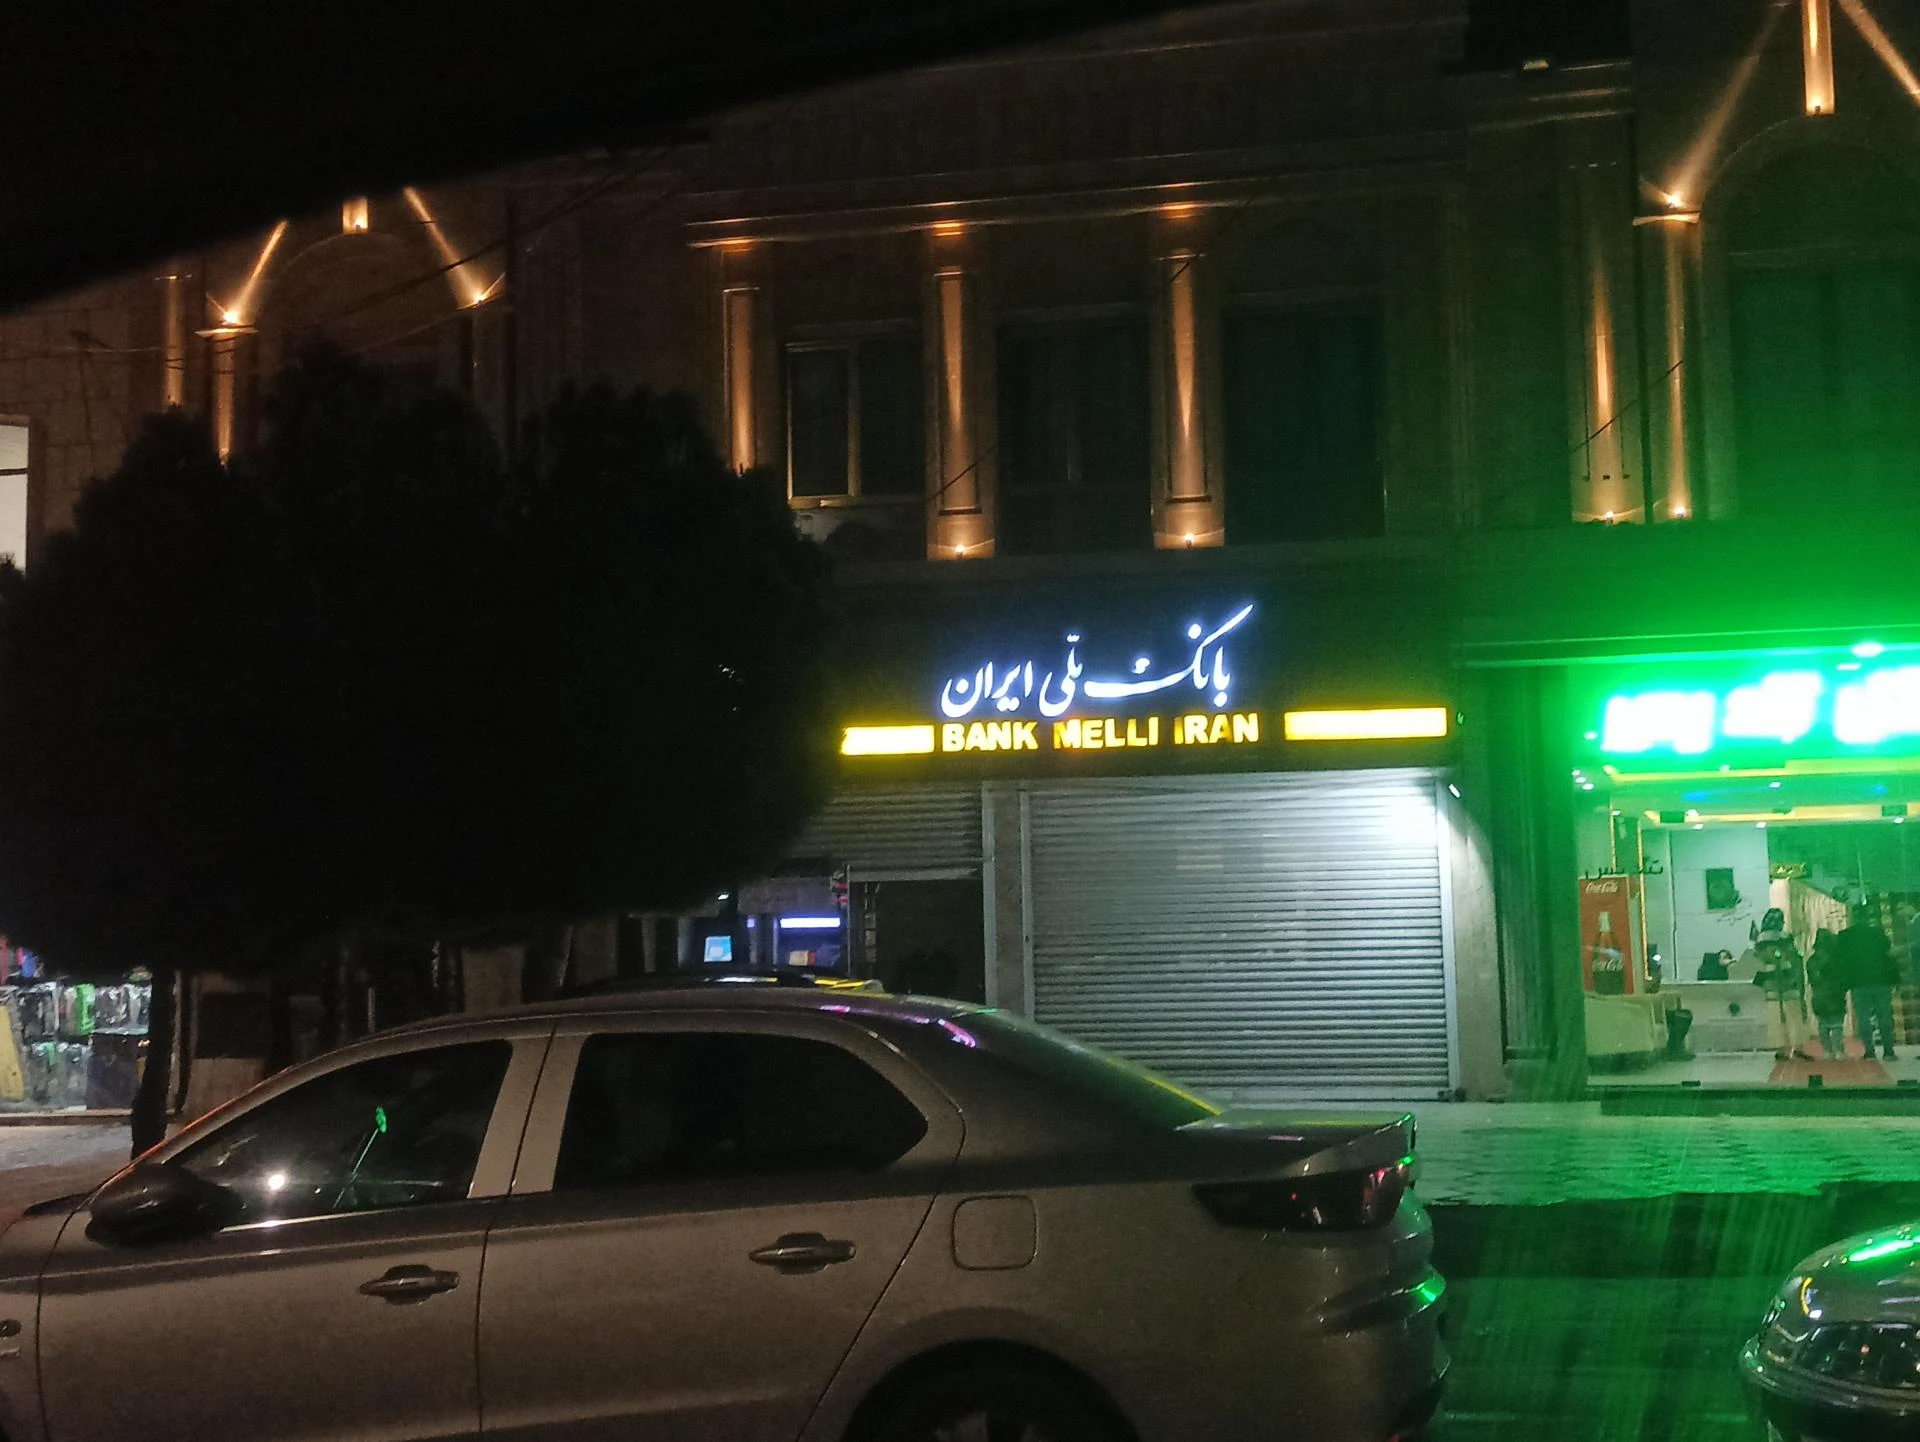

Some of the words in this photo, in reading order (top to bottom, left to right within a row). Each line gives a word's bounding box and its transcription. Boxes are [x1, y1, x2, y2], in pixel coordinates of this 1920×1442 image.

[1083, 603, 1254, 708] بانک
[940, 660, 1034, 718] ایران
[942, 719, 1039, 752] BANK
[1053, 716, 1159, 750] MELLI
[1174, 711, 1260, 745] IRAN
